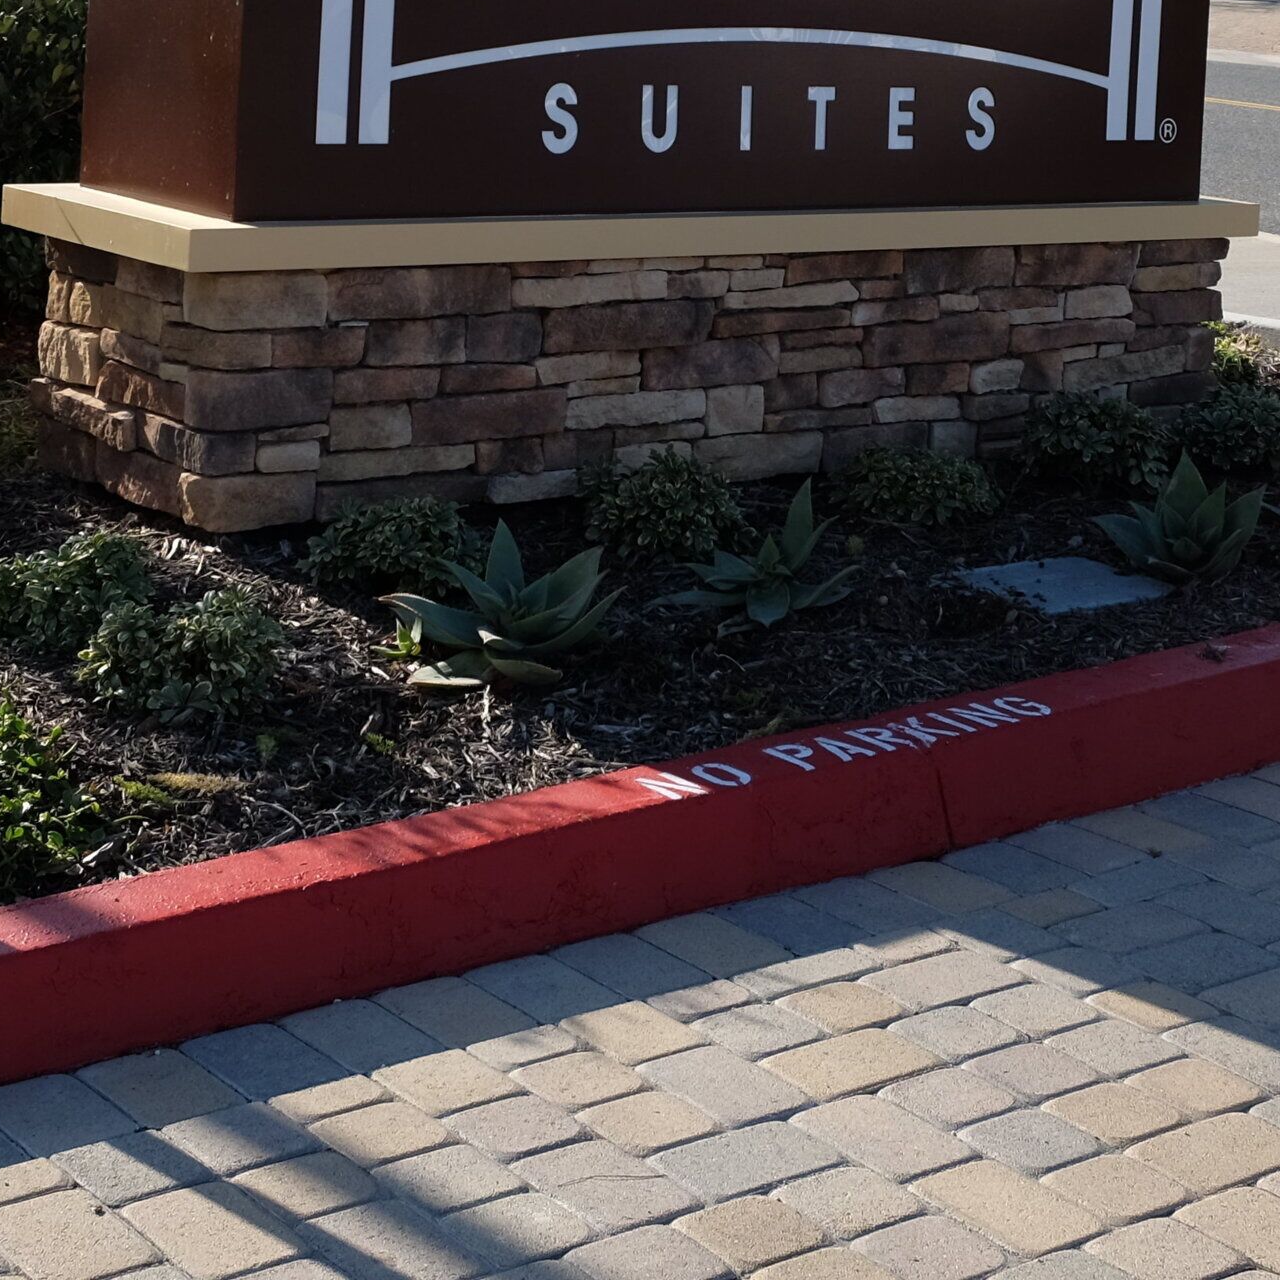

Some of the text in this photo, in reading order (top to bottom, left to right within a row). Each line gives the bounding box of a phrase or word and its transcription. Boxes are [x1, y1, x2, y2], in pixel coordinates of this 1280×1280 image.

[542, 82, 996, 154] SUITES
[634, 762, 752, 800] NO
[762, 696, 1052, 772] PARKING
